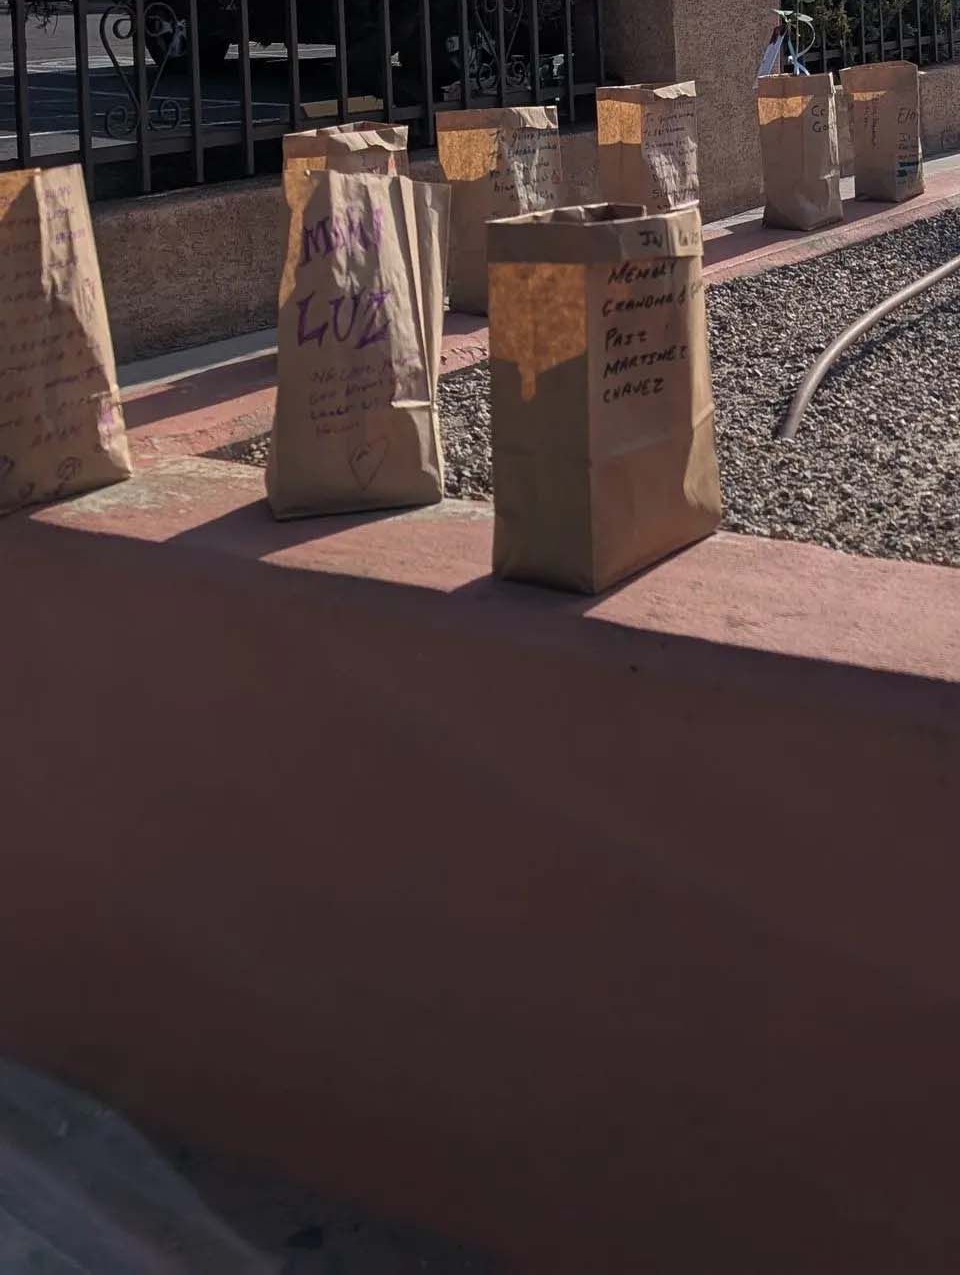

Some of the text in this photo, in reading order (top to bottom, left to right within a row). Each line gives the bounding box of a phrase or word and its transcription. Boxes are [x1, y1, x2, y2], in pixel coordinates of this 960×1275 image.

[296, 287, 391, 350] LUZ
[602, 345, 688, 379] MARTINEZ
[602, 377, 665, 404] CHAVEZ
